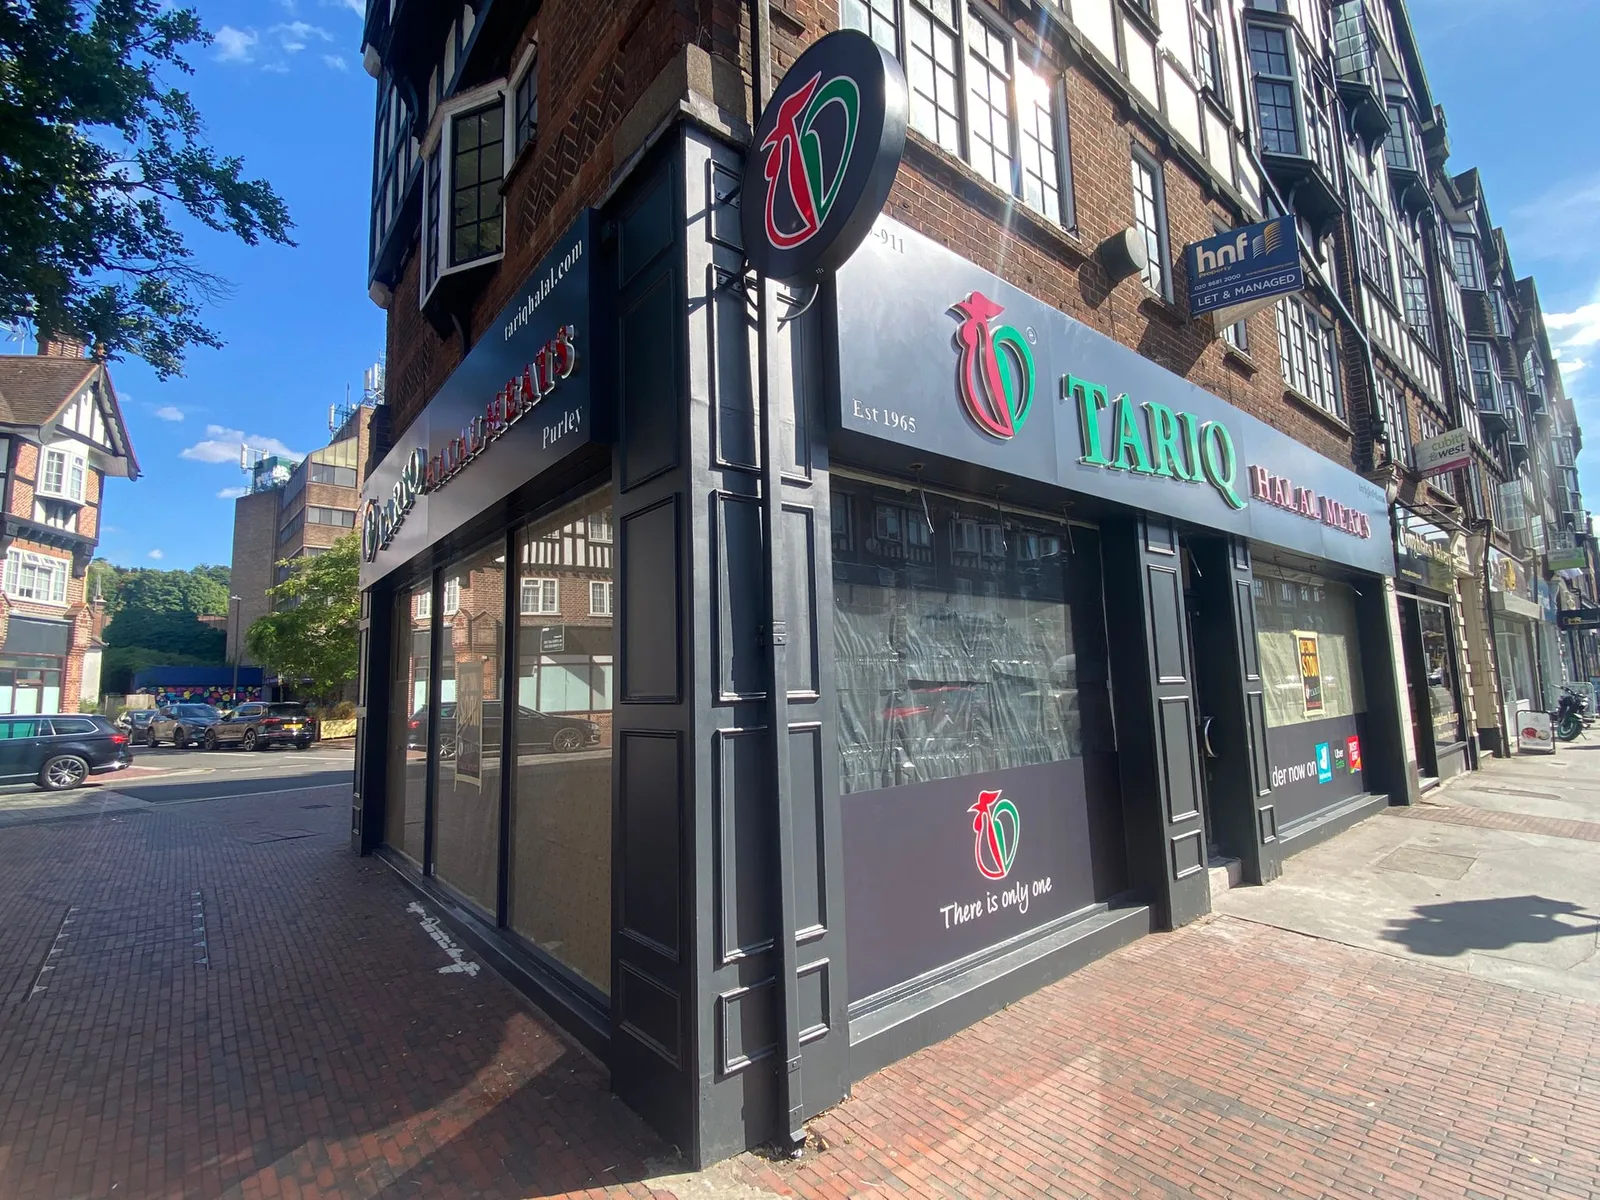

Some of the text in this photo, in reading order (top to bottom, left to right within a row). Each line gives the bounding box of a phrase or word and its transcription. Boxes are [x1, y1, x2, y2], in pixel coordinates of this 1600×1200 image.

[870, 228, 905, 255] -911
[1196, 233, 1248, 273] hnf
[504, 239, 583, 341] tariqhalal.com
[1194, 283, 1207, 291] 020
[1224, 273, 1241, 282] 2000
[1197, 273, 1296, 307] LET & MANAGED
[542, 405, 583, 450] Purley
[852, 398, 917, 433] Est 1965
[1061, 372, 1371, 539] TARIQ HALAL MEATS
[1431, 432, 1466, 451] cubitt
[1438, 442, 1466, 459] west
[1272, 760, 1318, 787] der now on
[940, 876, 1053, 929] There is only one
